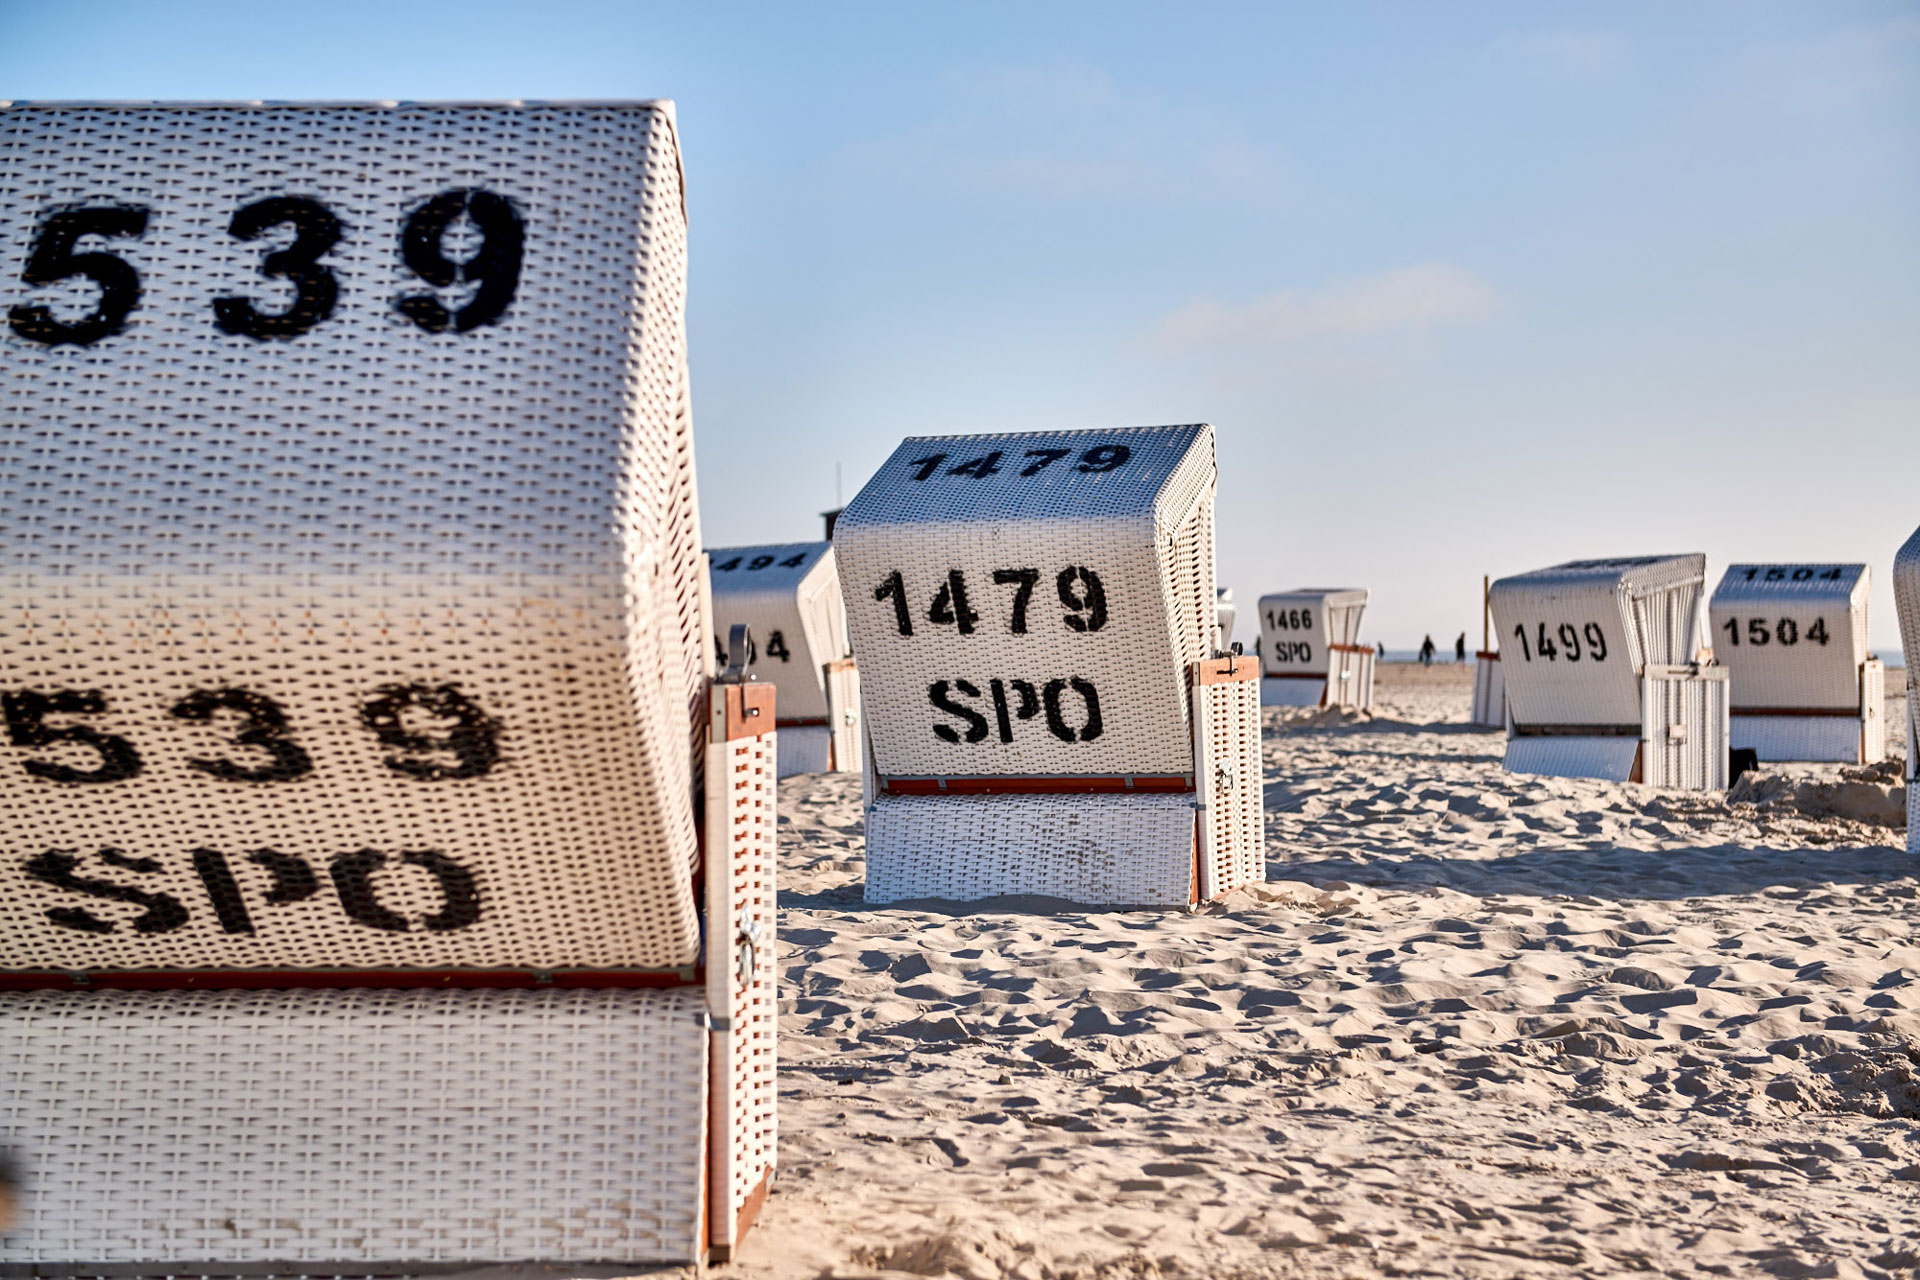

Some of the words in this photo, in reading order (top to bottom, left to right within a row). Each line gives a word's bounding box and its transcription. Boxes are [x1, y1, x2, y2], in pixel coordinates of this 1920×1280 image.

[8, 186, 526, 346] 539
[908, 444, 1131, 481] 1479
[709, 552, 806, 572] 494
[1742, 567, 1841, 582] 1504
[874, 565, 1108, 636] 1479
[1267, 608, 1312, 631] 1466
[1514, 621, 1607, 662] 1499
[1723, 616, 1829, 646] 1504
[1275, 641, 1312, 663] SPO
[929, 675, 1103, 744] SPO
[1, 681, 501, 783] 539
[24, 847, 482, 935] SPO
